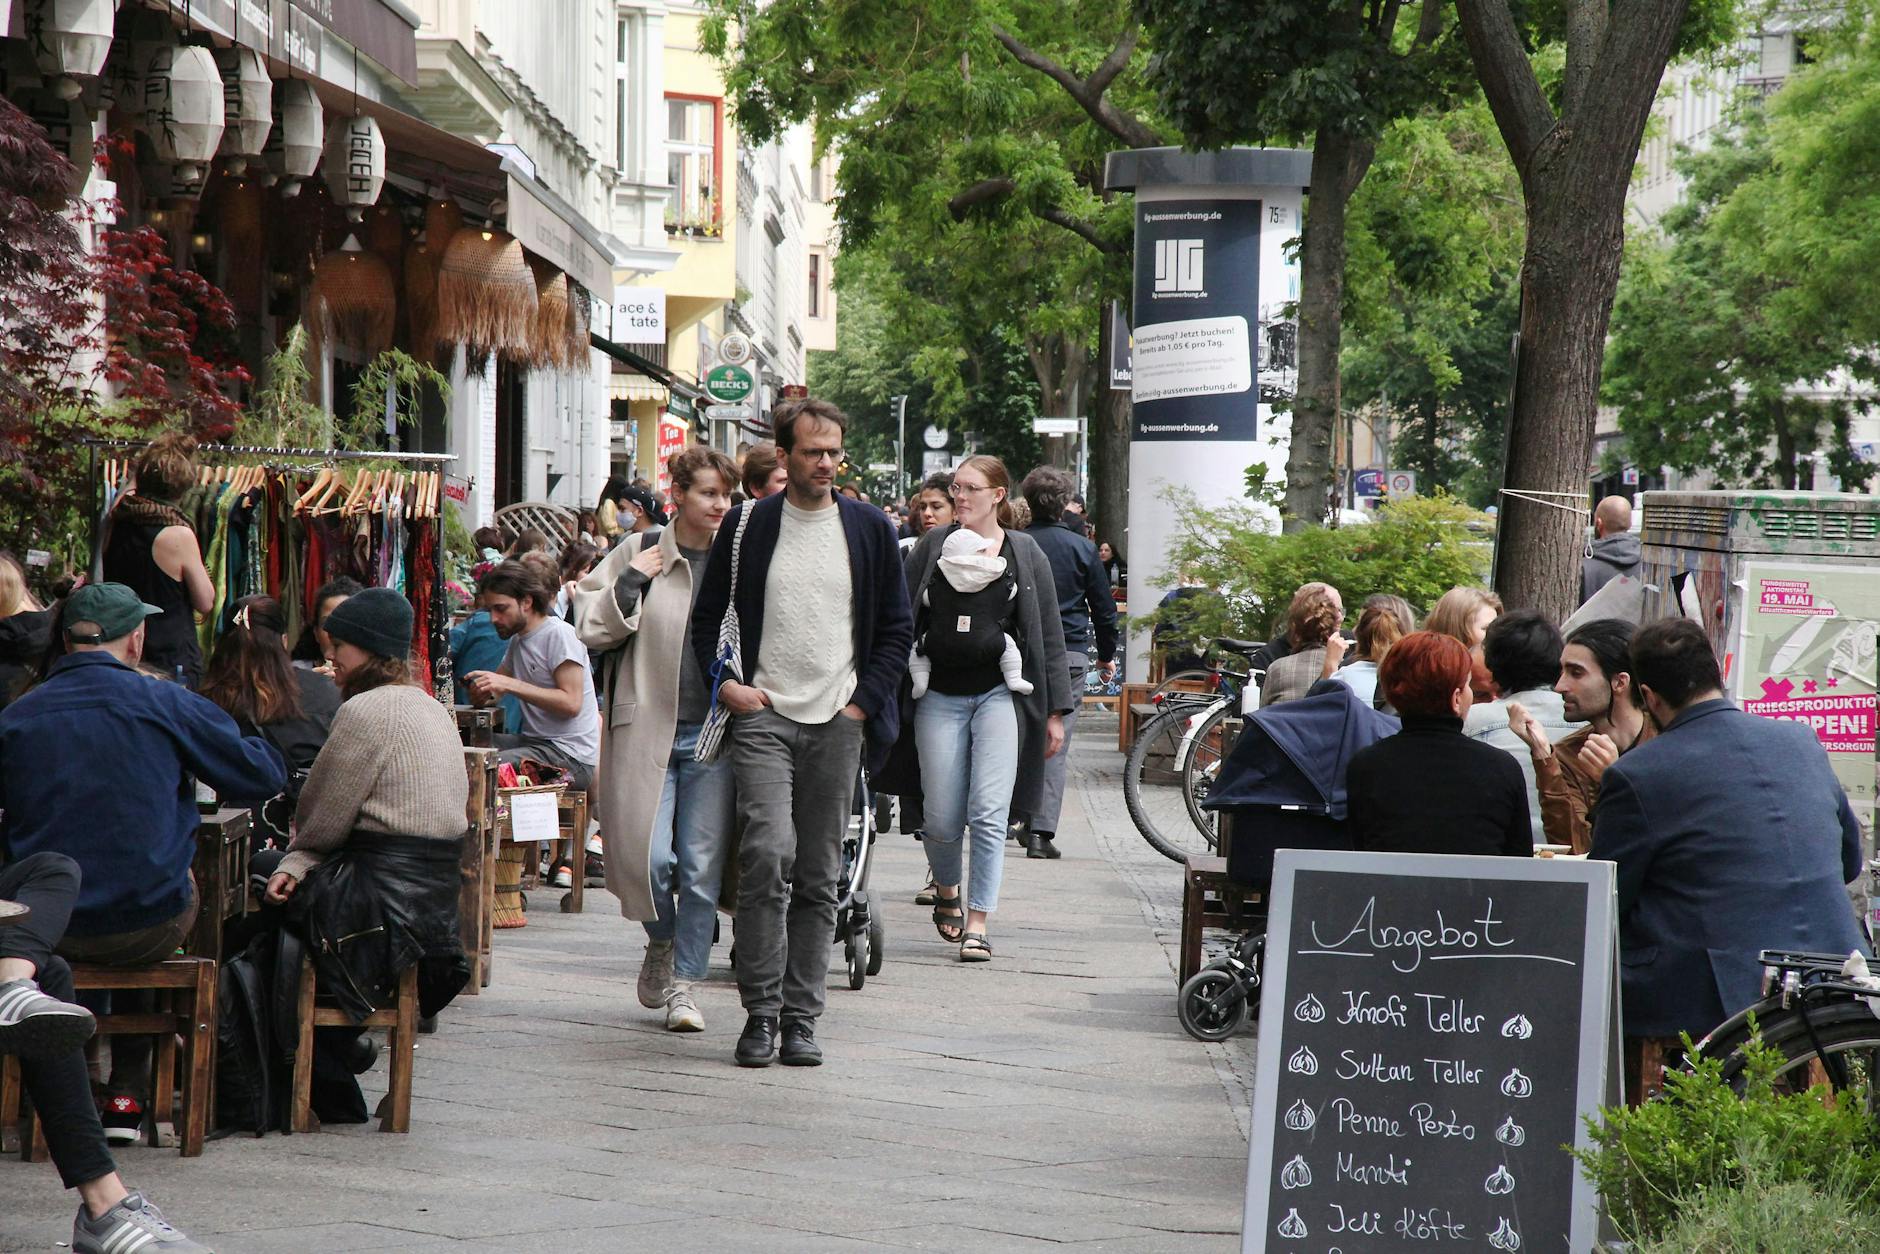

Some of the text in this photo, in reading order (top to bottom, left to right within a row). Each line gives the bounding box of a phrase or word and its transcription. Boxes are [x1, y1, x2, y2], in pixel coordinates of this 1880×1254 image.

[1269, 206, 1279, 223] 75
[619, 302, 658, 314] ace &
[630, 316, 659, 328] tate
[1180, 330, 1199, 340] Jetzt
[1201, 327, 1235, 337] buchen!
[1158, 343, 1166, 352] ab
[1184, 341, 1191, 349] €
[1191, 341, 1206, 350] pro
[1207, 339, 1225, 348] Tag.
[710, 380, 749, 390] BECK'S
[1761, 580, 1808, 588] BUNDESWEITER
[1763, 593, 1810, 606] 19. MAI
[1312, 896, 1515, 973] Angebot
[1336, 990, 1486, 1033] Knofi Teller
[1335, 1050, 1485, 1085] Sultan Teller
[1331, 1097, 1476, 1141] Penne Pesto
[1336, 1151, 1413, 1186] Manti
